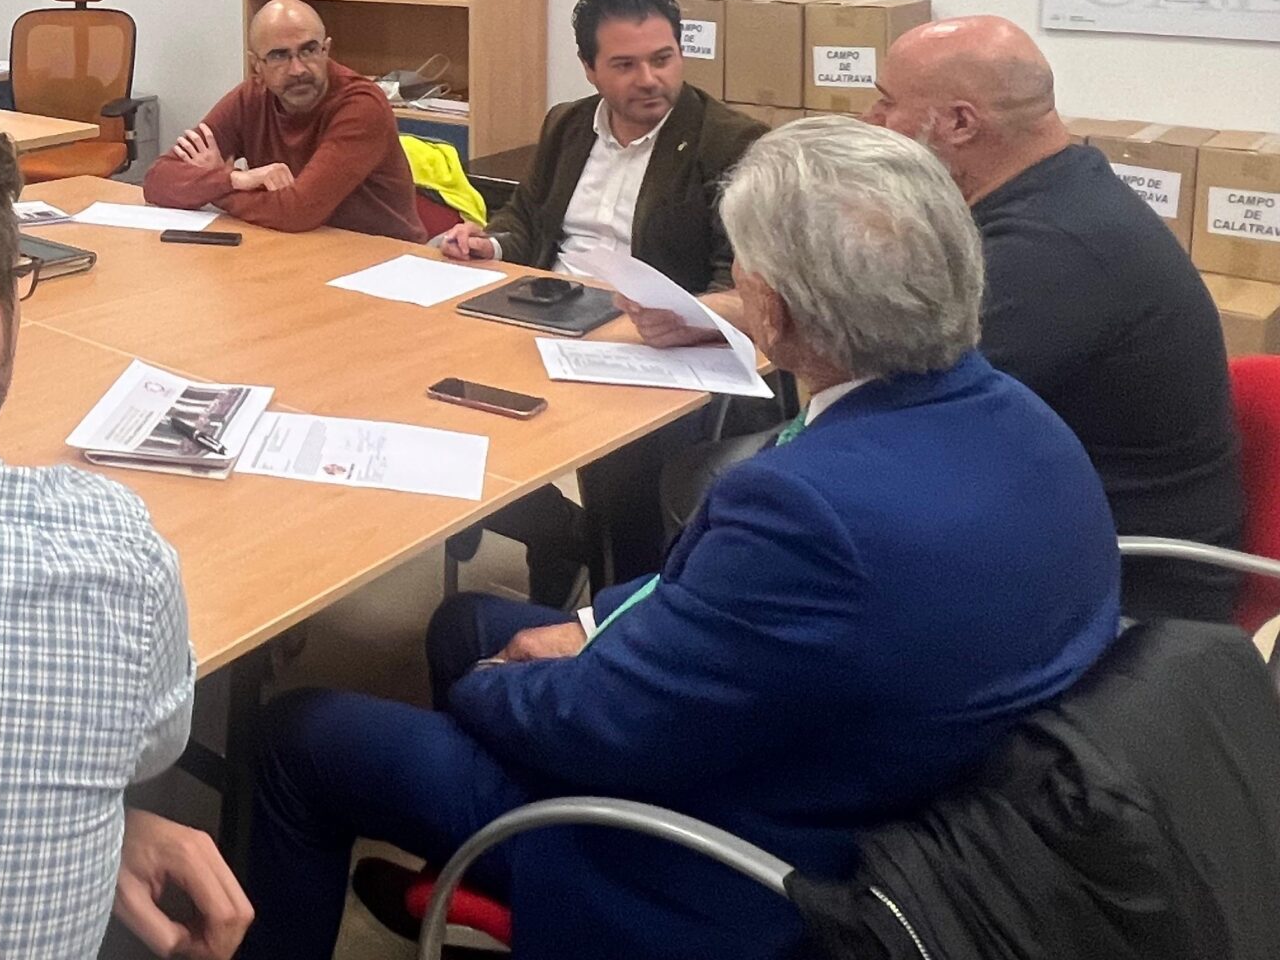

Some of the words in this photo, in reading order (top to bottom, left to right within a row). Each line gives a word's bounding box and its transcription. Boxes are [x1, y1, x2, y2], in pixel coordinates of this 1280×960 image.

[680, 23, 703, 32] AMPO
[684, 34, 695, 43] DE
[826, 50, 860, 60] CAMPO
[839, 62, 851, 71] DE
[818, 73, 873, 83] CALATRAVA
[1122, 175, 1145, 187] MPO
[1147, 178, 1162, 189] DE
[1228, 193, 1275, 208] CAMPO
[1243, 209, 1263, 220] DE
[1213, 219, 1280, 237] CALATRAV
